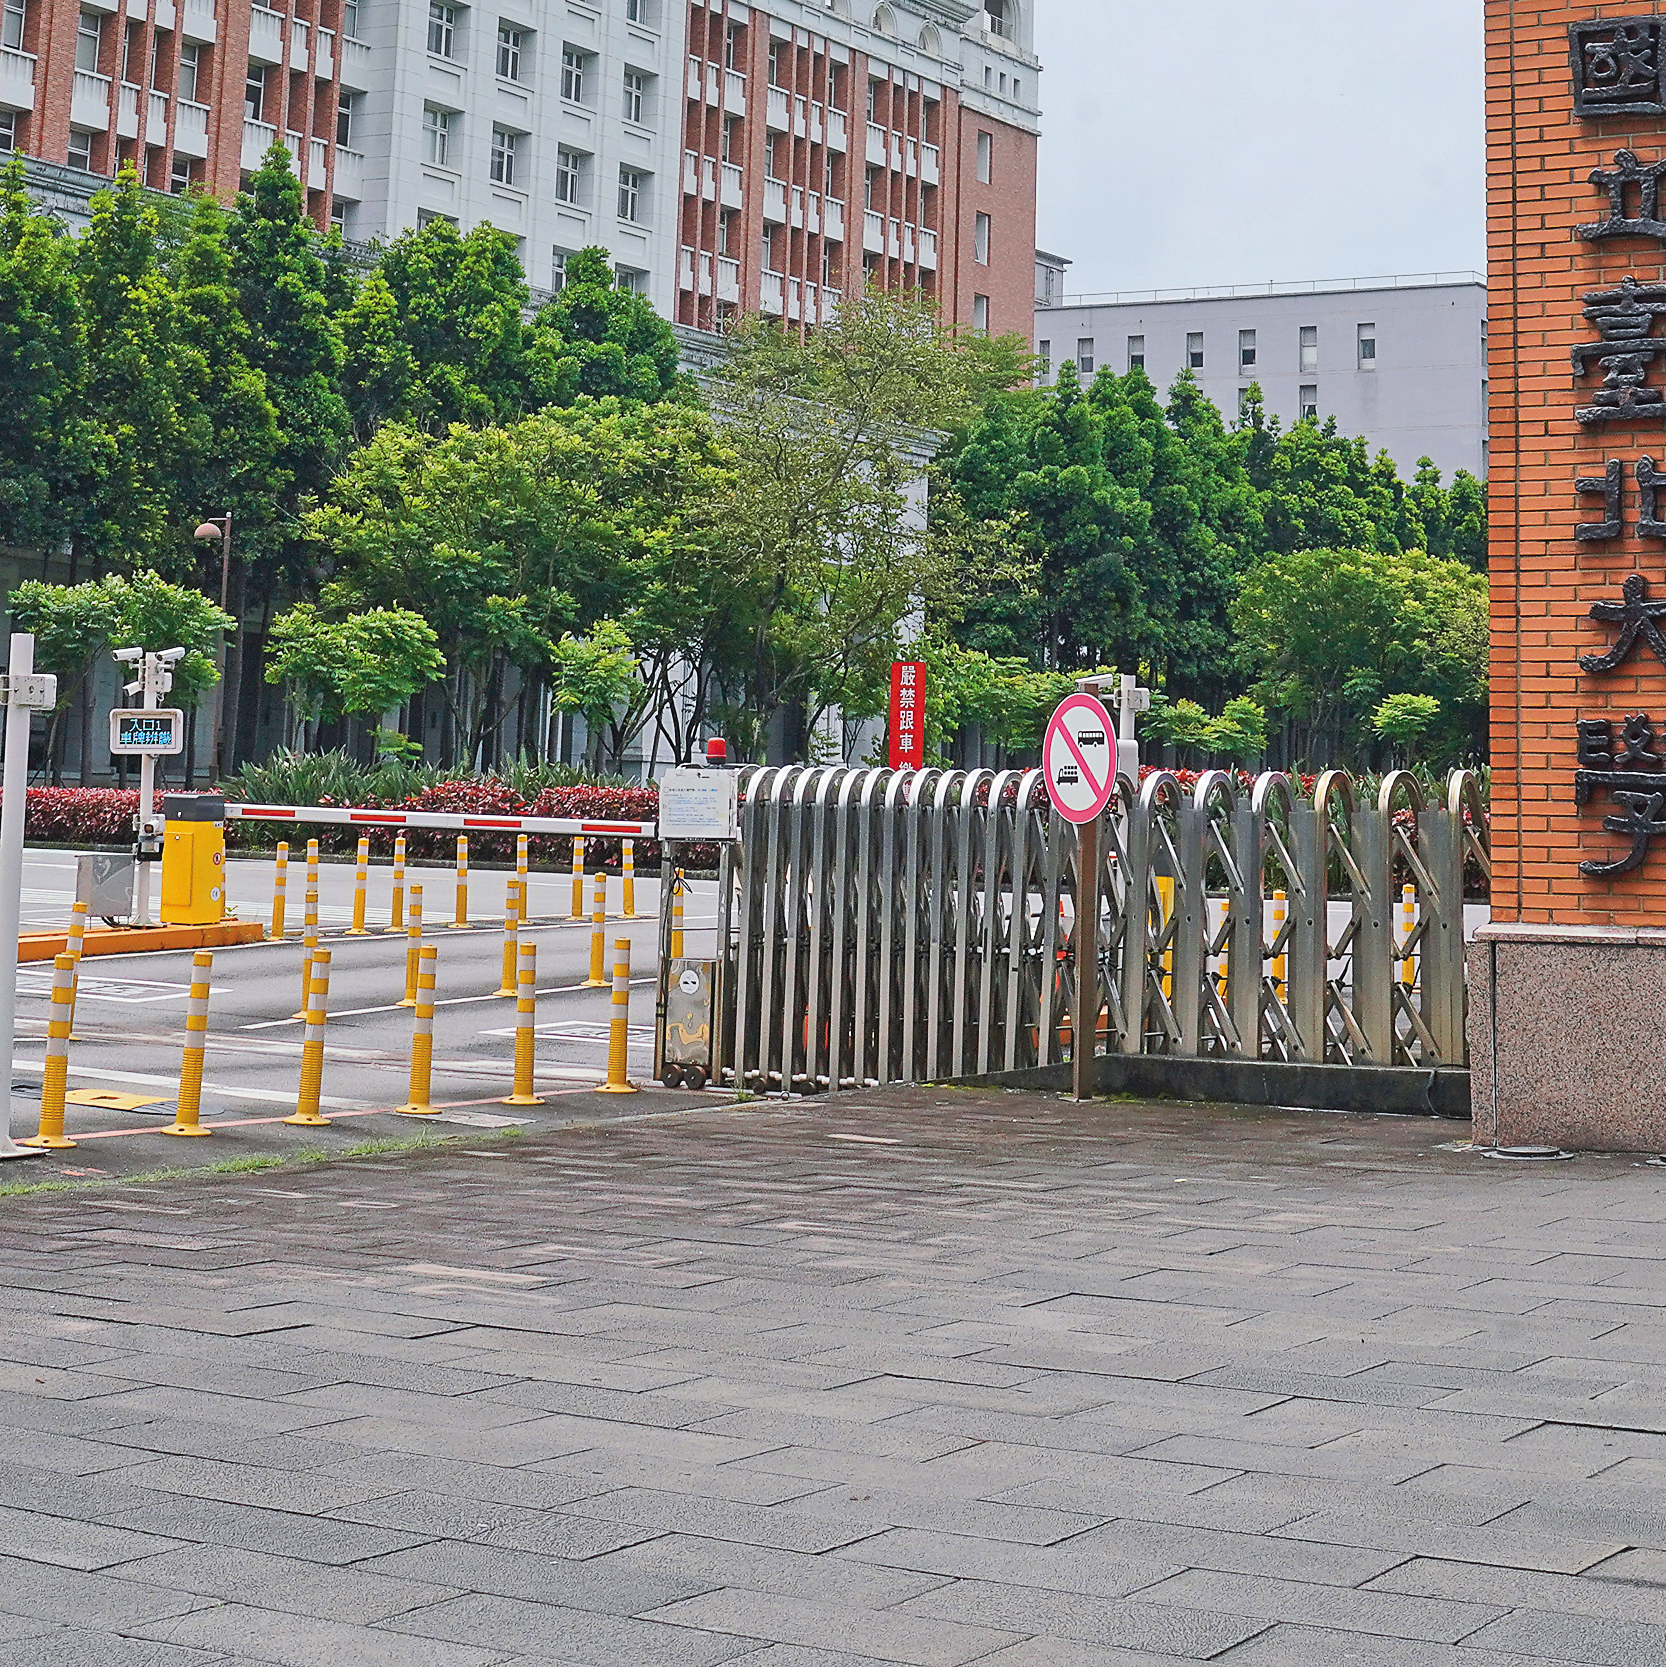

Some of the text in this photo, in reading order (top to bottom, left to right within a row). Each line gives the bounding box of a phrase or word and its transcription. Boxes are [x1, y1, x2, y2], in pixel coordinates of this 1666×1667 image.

[129, 718, 162, 731] 入口1
[899, 665, 916, 753] 嚴禁跟車
